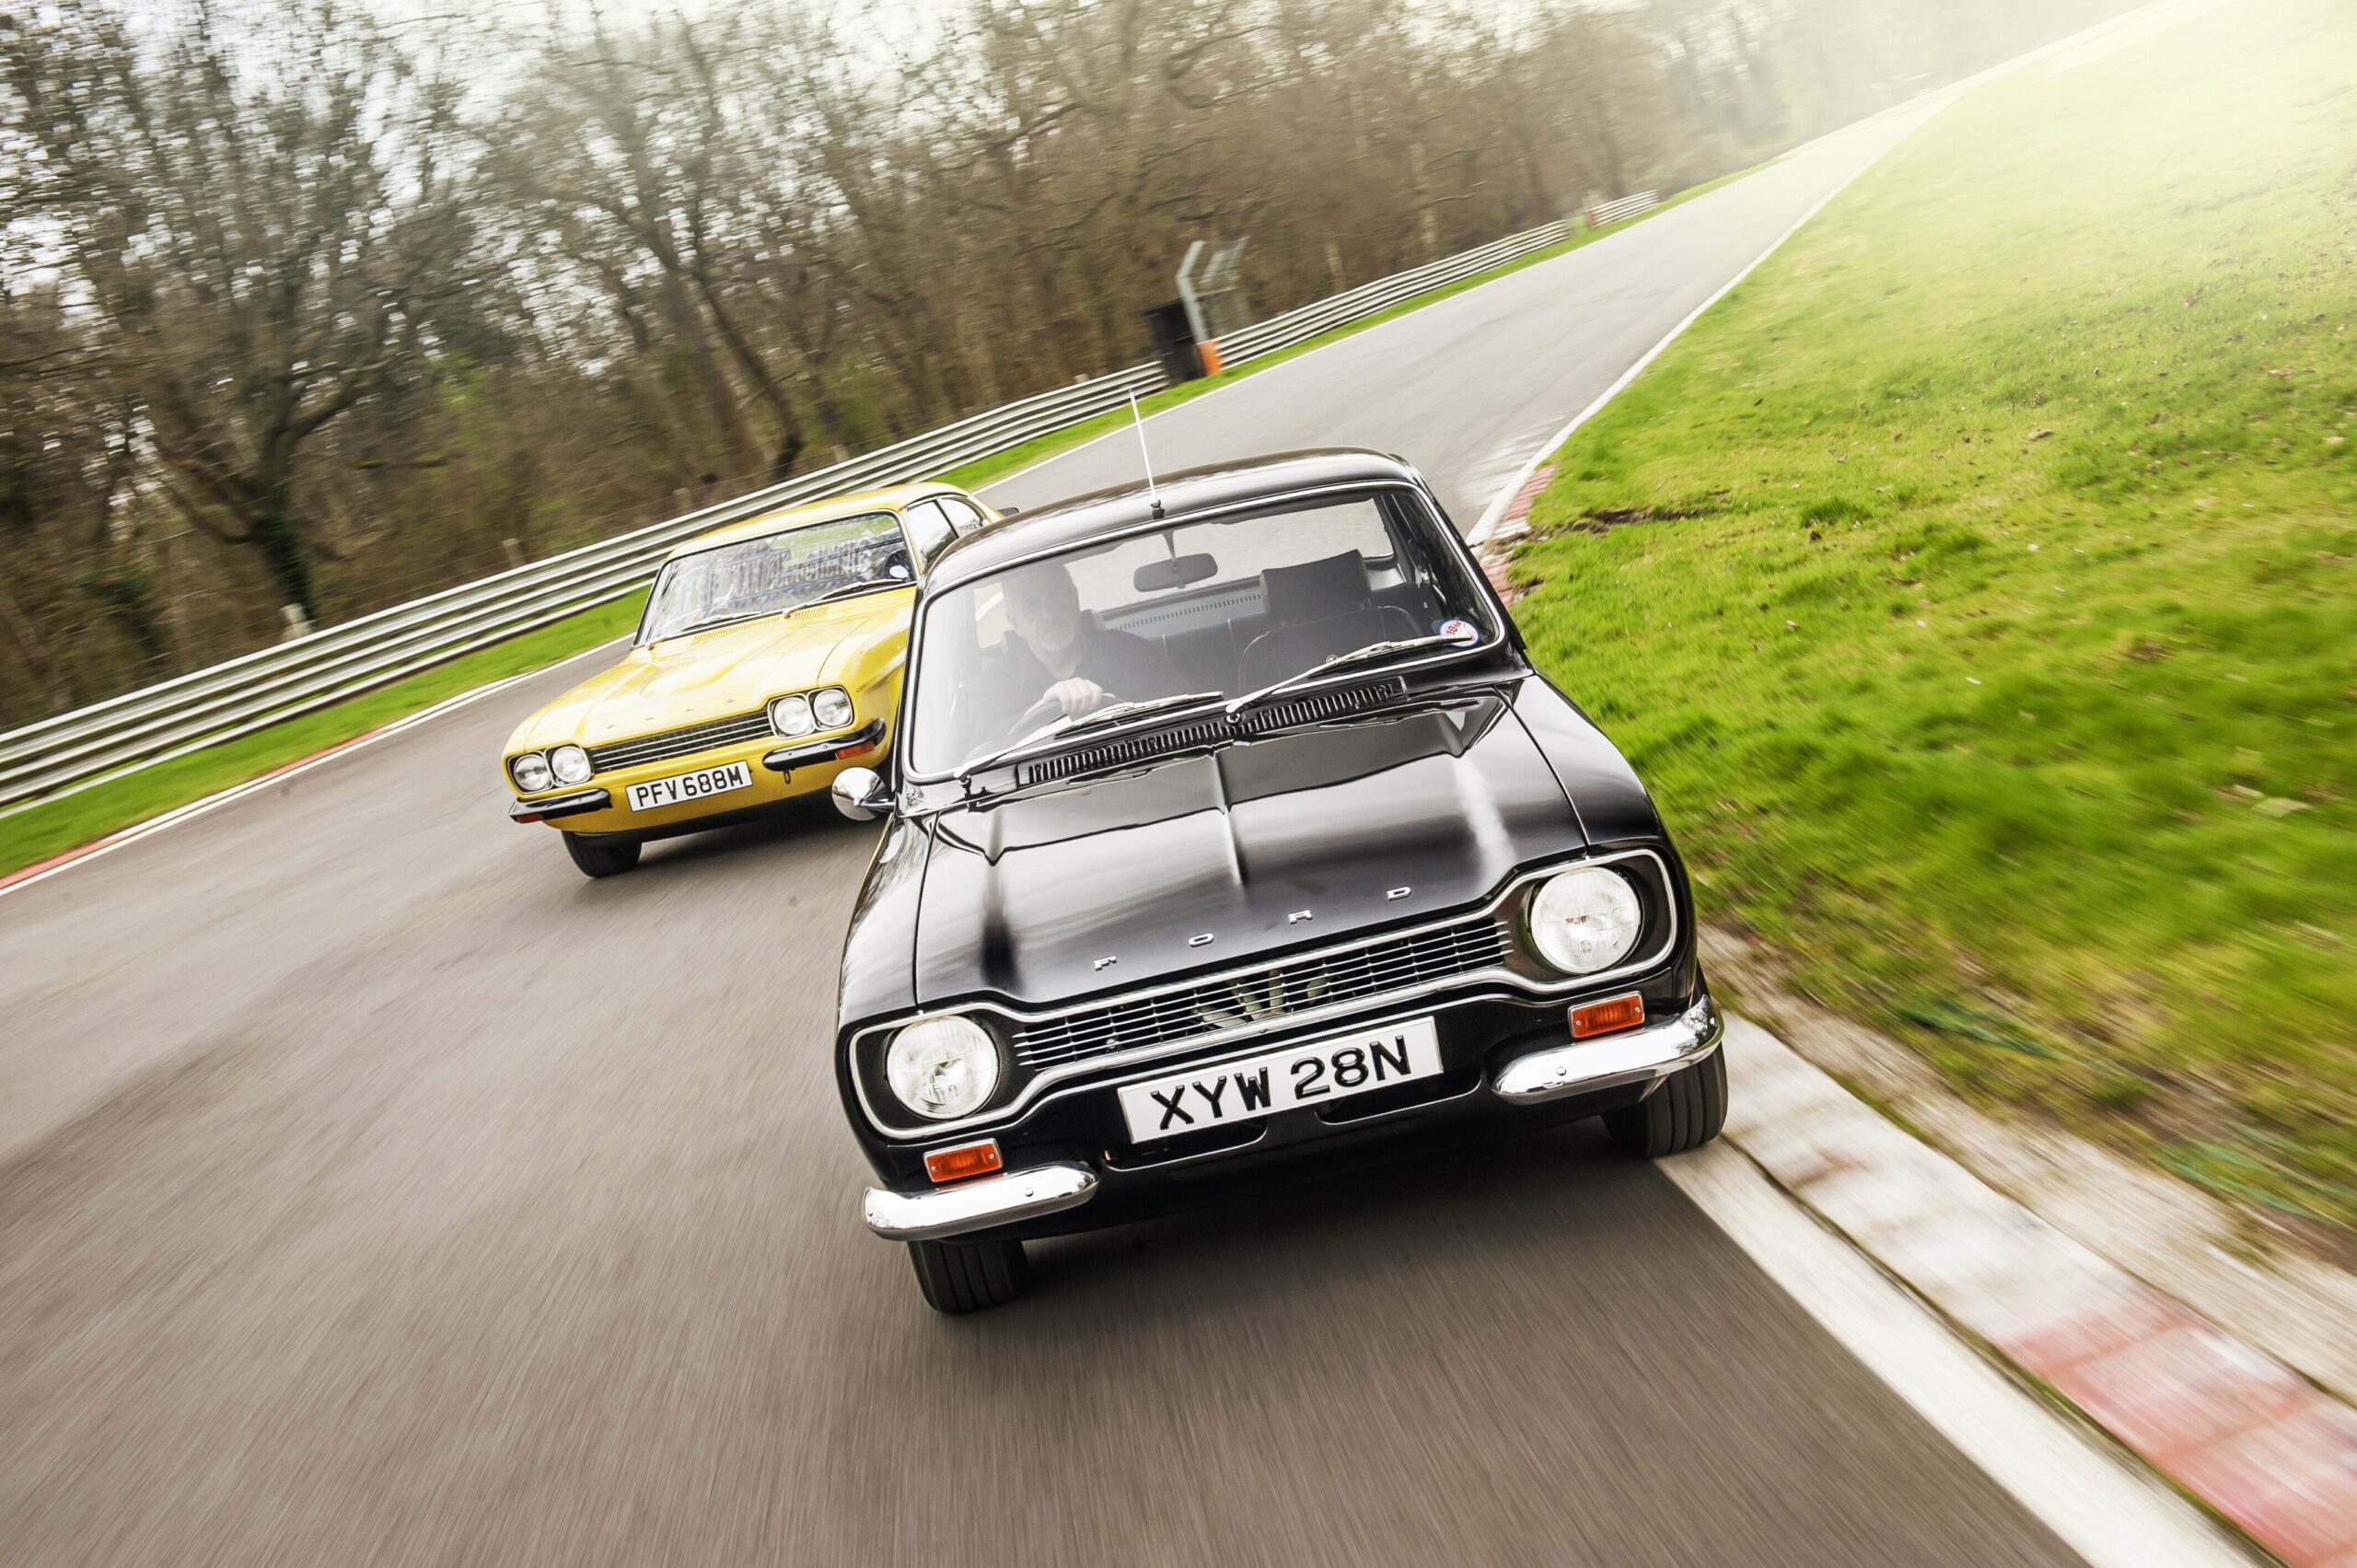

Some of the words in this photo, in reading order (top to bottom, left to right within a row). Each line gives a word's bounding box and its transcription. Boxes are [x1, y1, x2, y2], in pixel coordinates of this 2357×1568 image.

[635, 779, 678, 807] PFV
[682, 765, 744, 797] 688M
[1093, 886, 1411, 971] FORD
[1150, 1066, 1271, 1131] XYW
[1290, 1034, 1411, 1100] 28N
